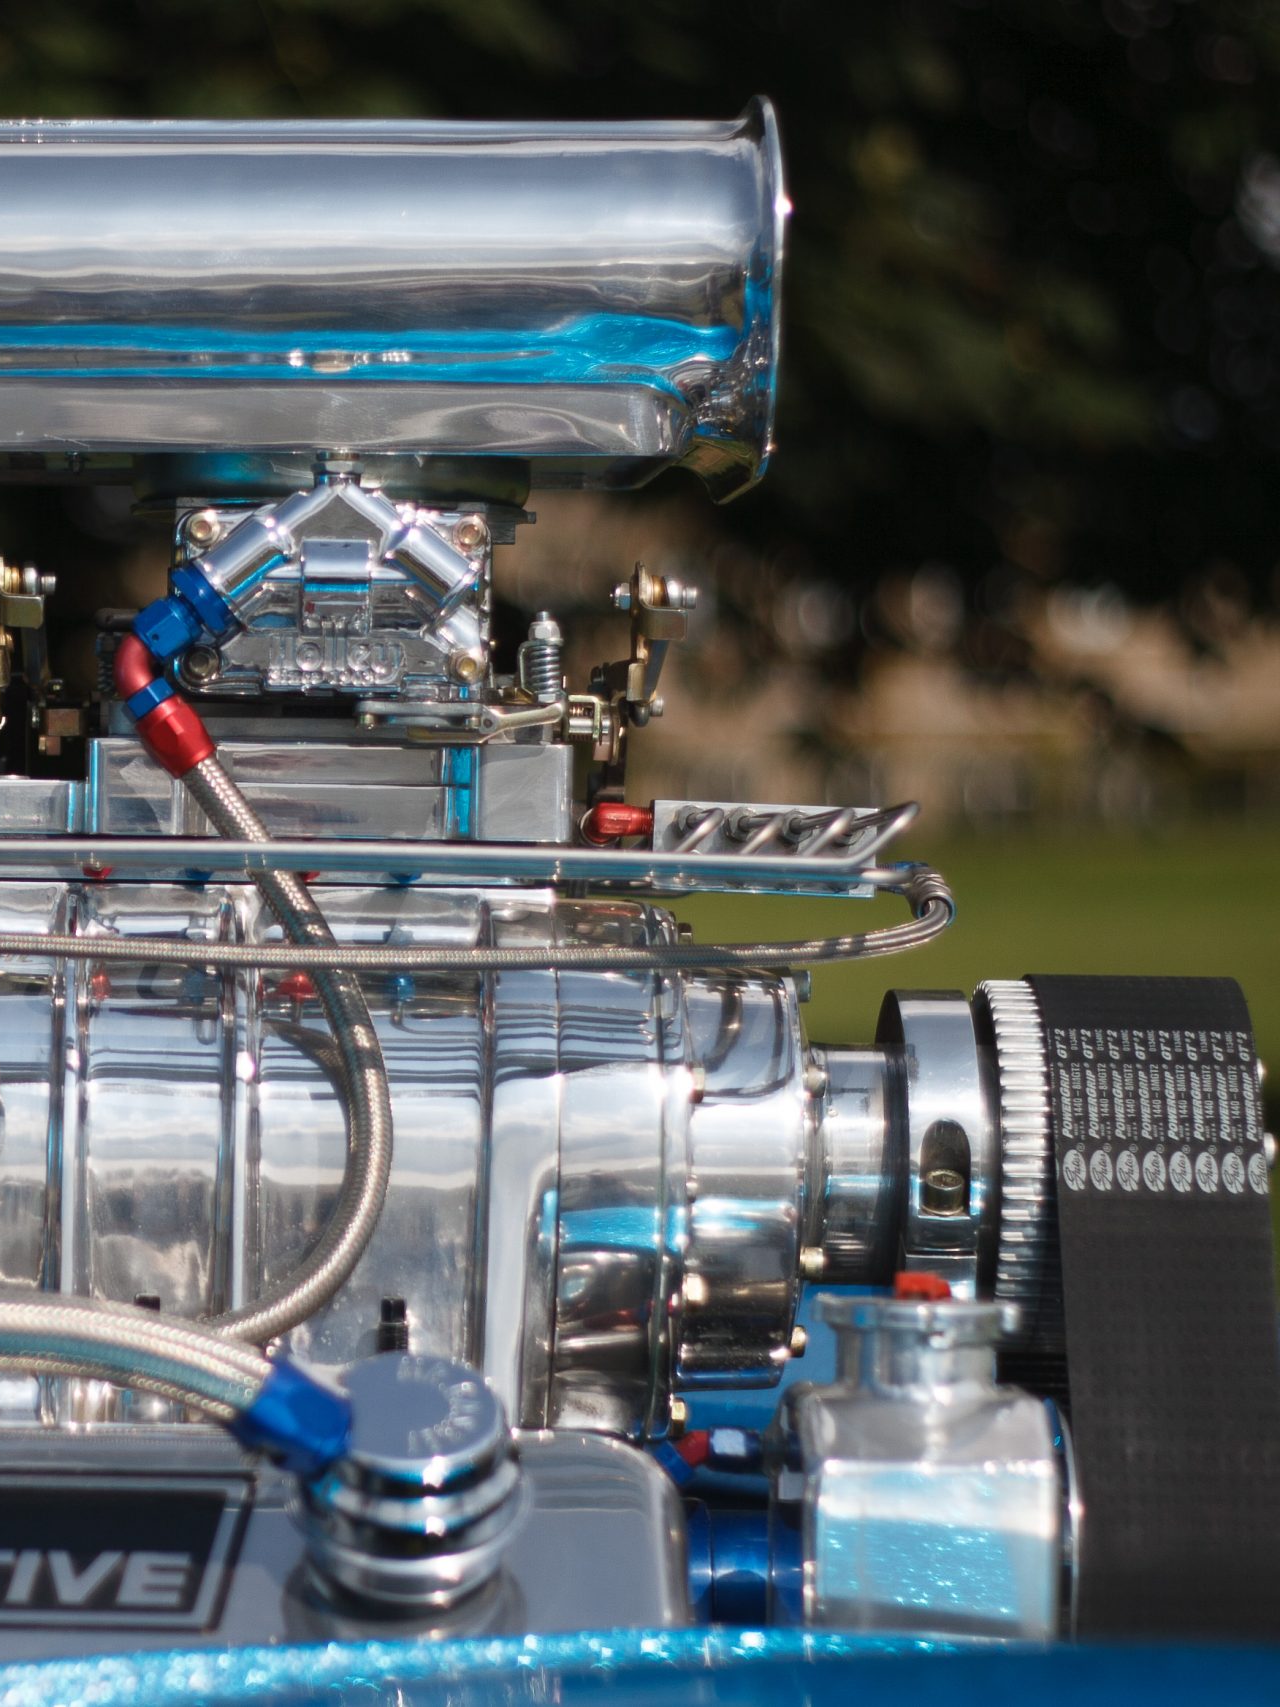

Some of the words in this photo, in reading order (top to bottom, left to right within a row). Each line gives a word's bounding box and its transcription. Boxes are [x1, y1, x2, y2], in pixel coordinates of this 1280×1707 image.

[1060, 1068, 1074, 1138] POWERGRIP
[1086, 1069, 1100, 1139] POWERGRIP
[1112, 1070, 1126, 1140] POWERGRIP
[1138, 1070, 1152, 1140] POWERGRIP
[1165, 1070, 1179, 1140] POWERGRIP
[1190, 1071, 1204, 1141] POWERGRIP
[1217, 1071, 1231, 1141] POWERGRIP
[1243, 1072, 1257, 1142] POWERGRIP
[1064, 1151, 1085, 1190] Gates
[1090, 1152, 1111, 1190] Gates
[1117, 1152, 1138, 1191] Gates
[1143, 1152, 1164, 1192] Gates
[1169, 1153, 1190, 1192] Gates
[1195, 1153, 1216, 1192] Gates
[1221, 1154, 1242, 1193] Gates
